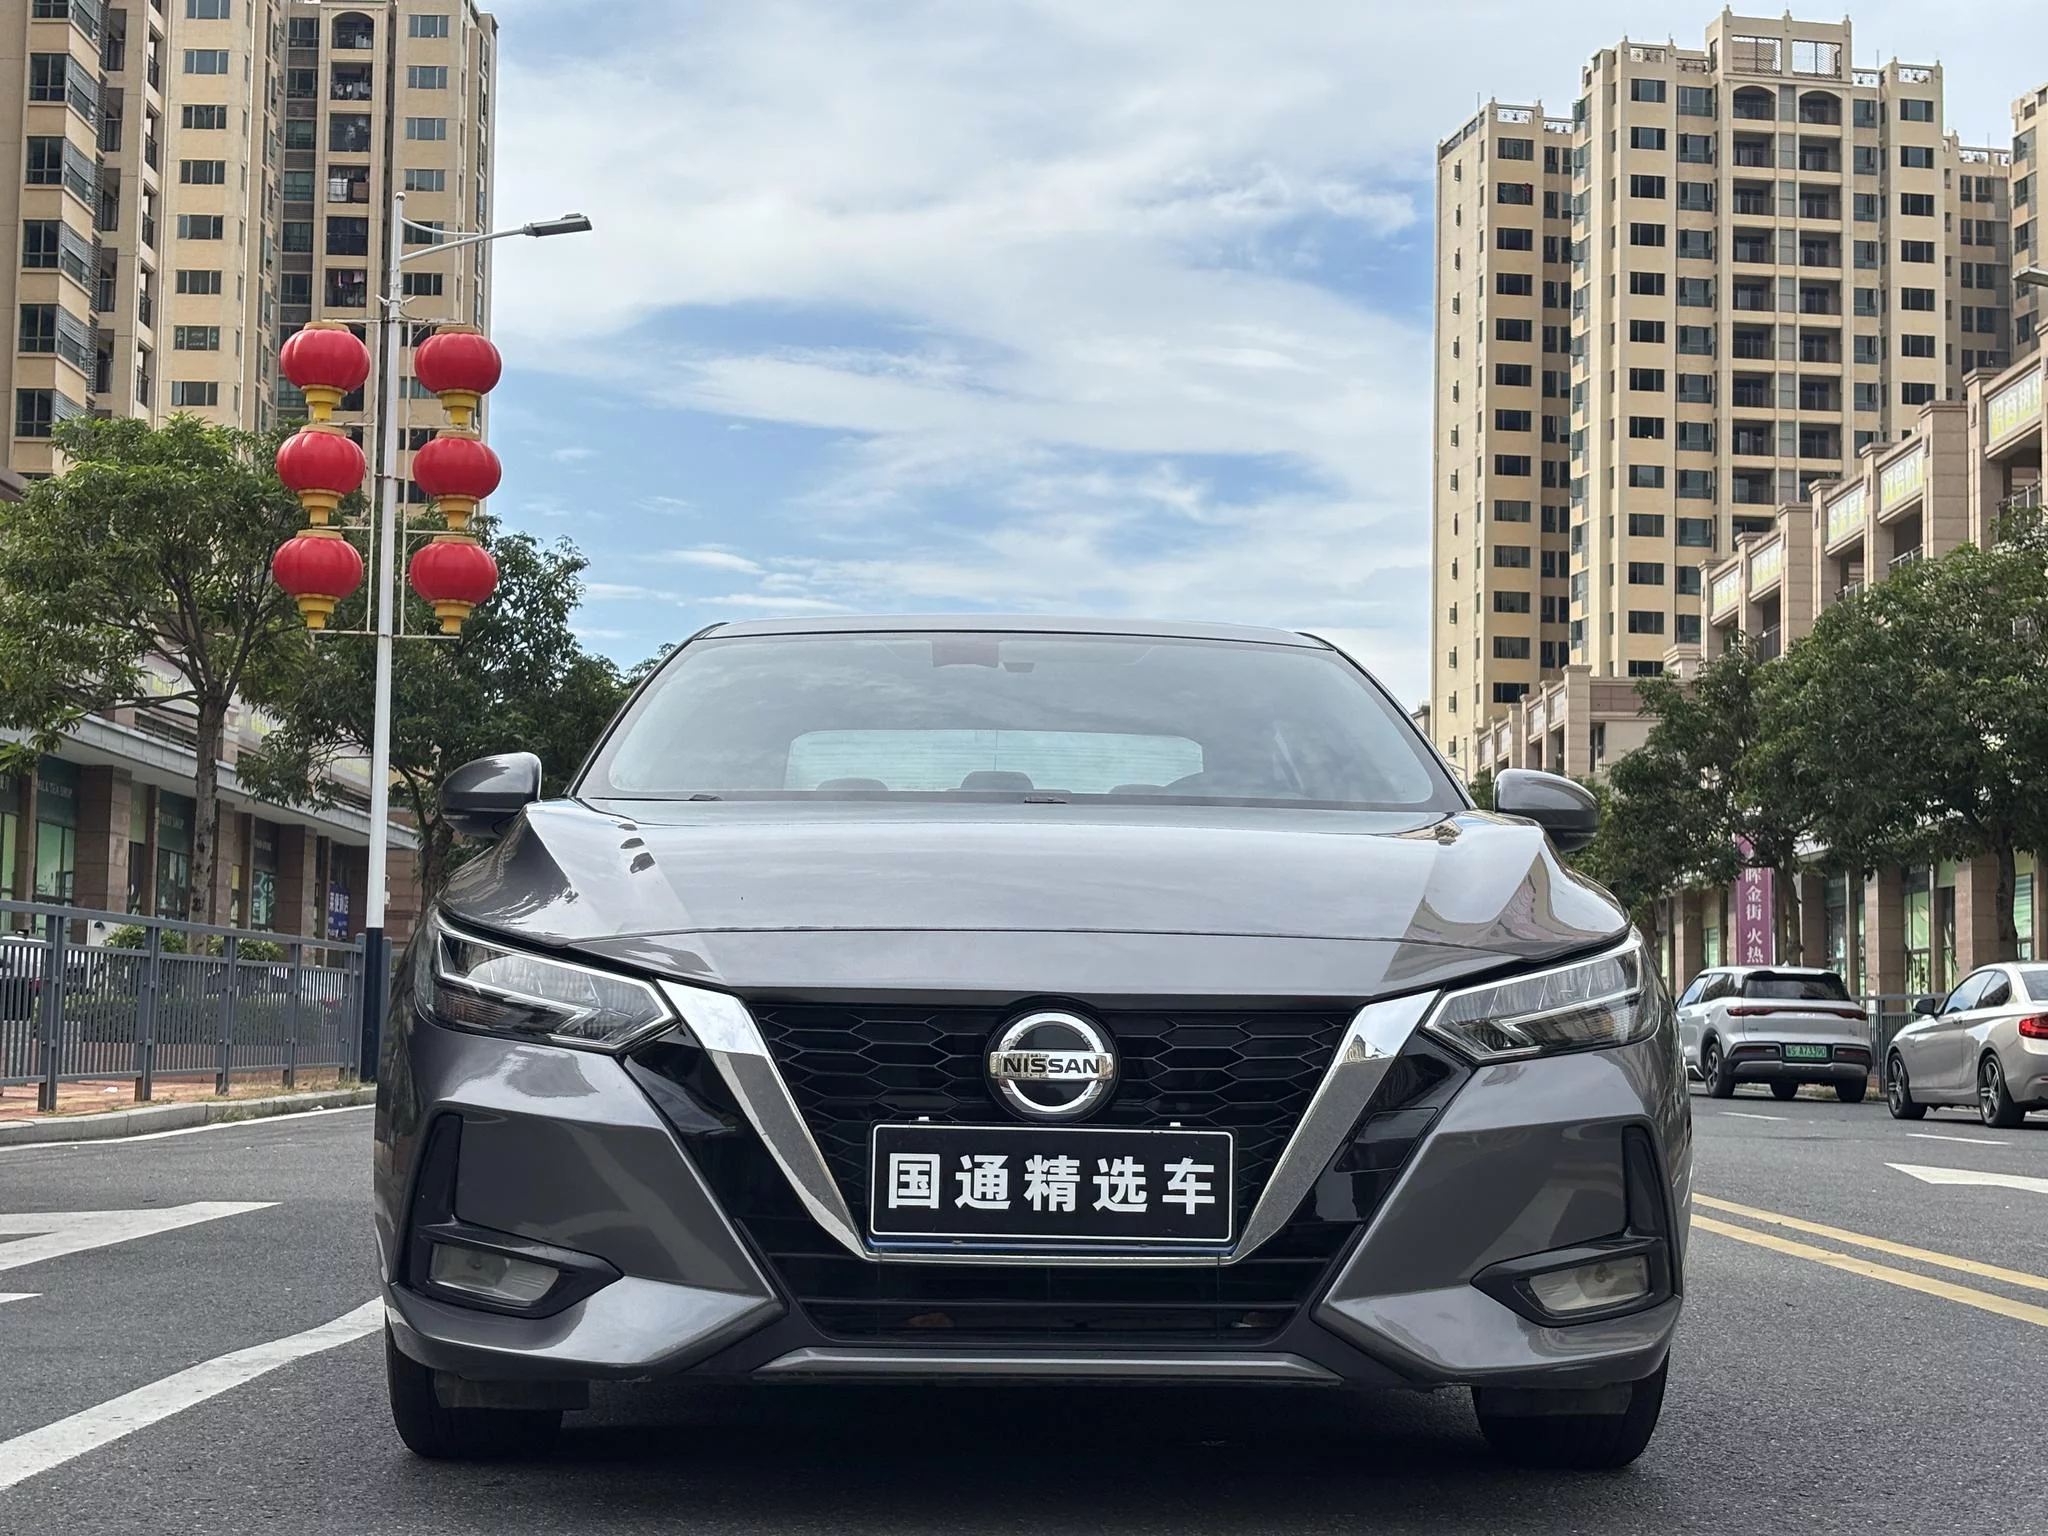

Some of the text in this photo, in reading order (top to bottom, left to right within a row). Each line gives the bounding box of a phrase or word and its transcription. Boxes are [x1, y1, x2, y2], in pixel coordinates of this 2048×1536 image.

[1003, 1056, 1100, 1075] NISSAN
[887, 1152, 1216, 1215] 国通精选车
